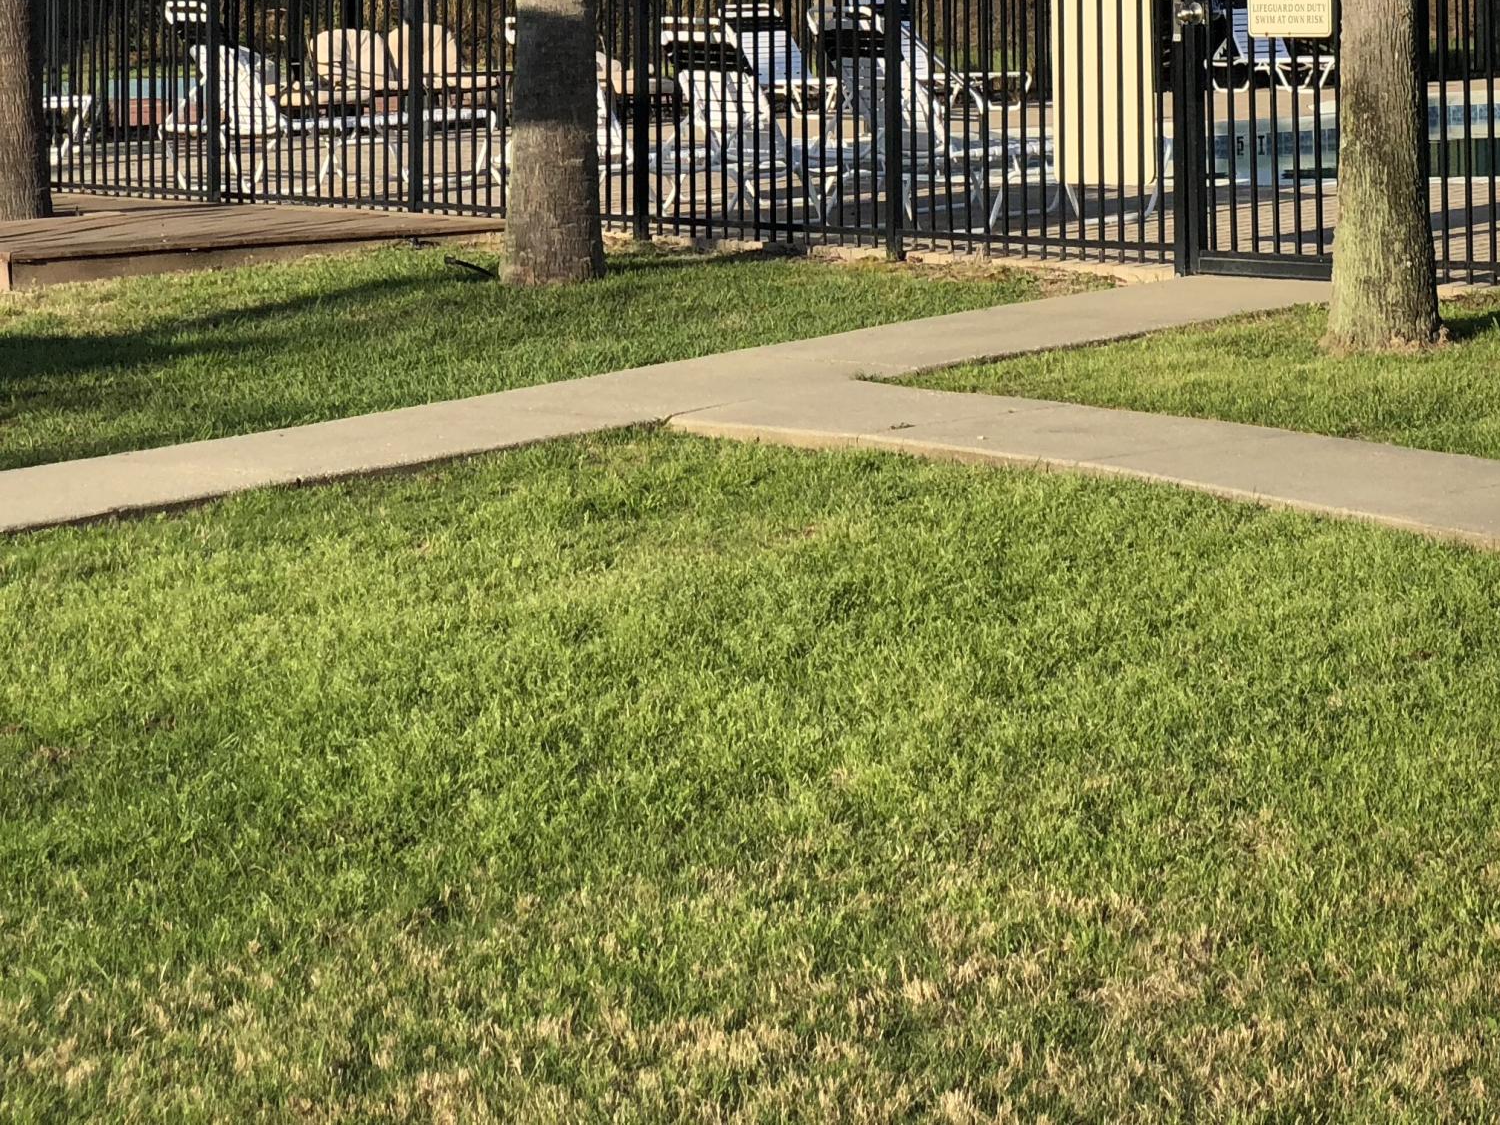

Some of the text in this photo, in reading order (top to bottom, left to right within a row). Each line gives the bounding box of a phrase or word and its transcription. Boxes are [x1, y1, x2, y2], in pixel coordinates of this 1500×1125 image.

[1252, 3, 1326, 13] LIFEGUARD ON DUTY
[1255, 15, 1323, 24] SWIM AT OWN RISK
